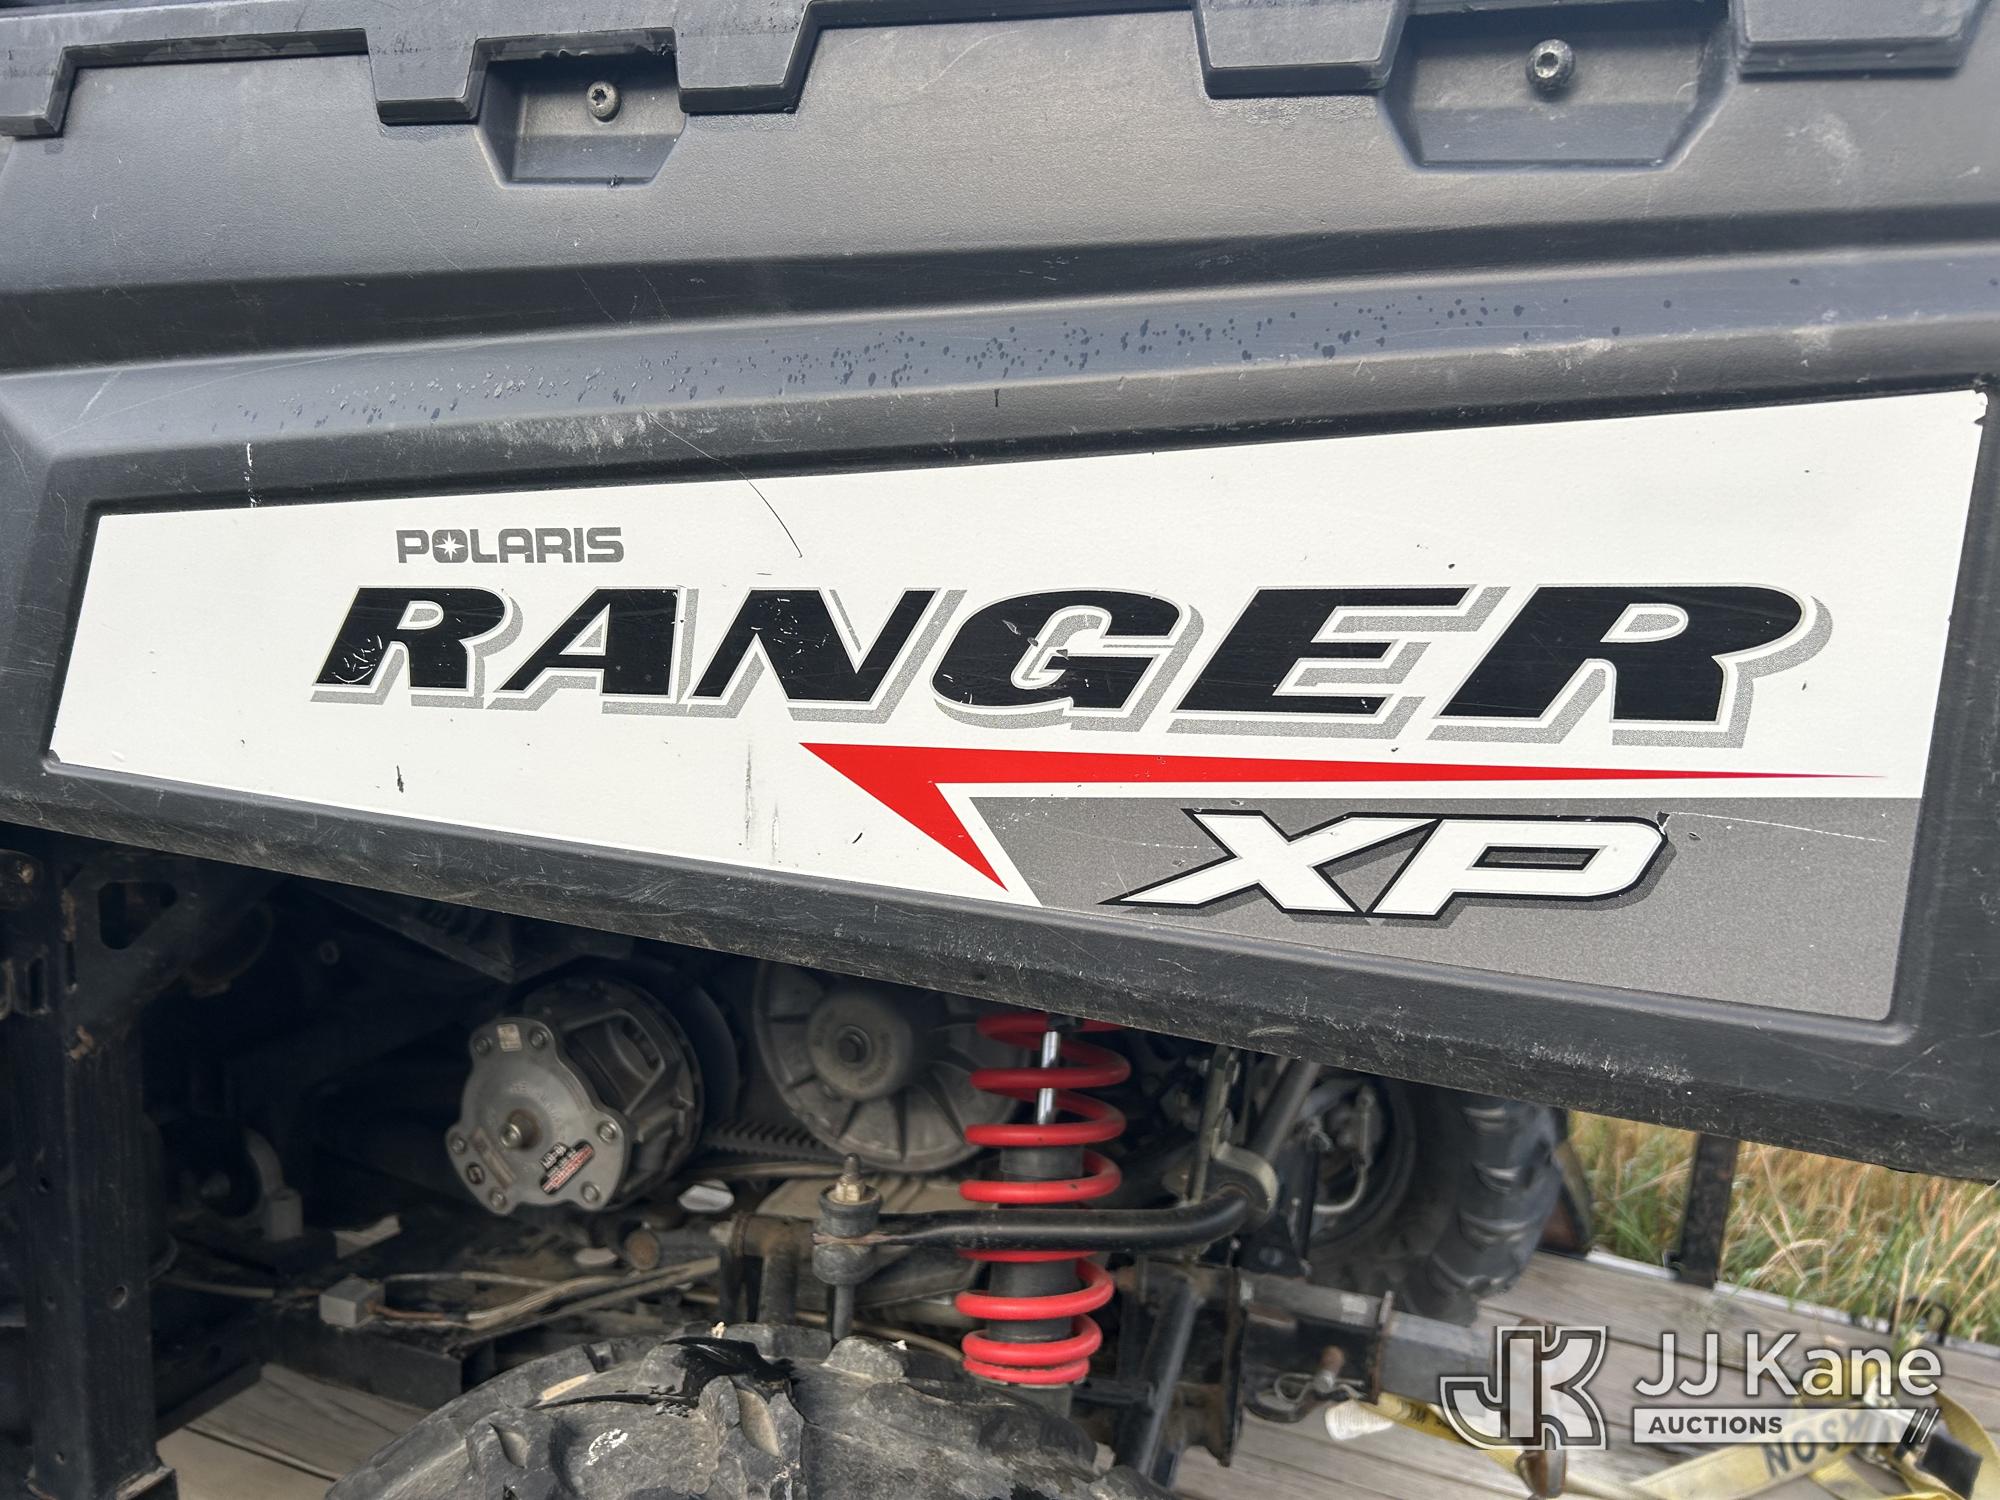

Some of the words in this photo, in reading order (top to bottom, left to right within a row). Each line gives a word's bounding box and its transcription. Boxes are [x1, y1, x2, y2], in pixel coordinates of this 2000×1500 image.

[396, 527, 625, 564] POLARIS
[310, 585, 1833, 748] RANGER
[1097, 807, 1676, 926] XP
